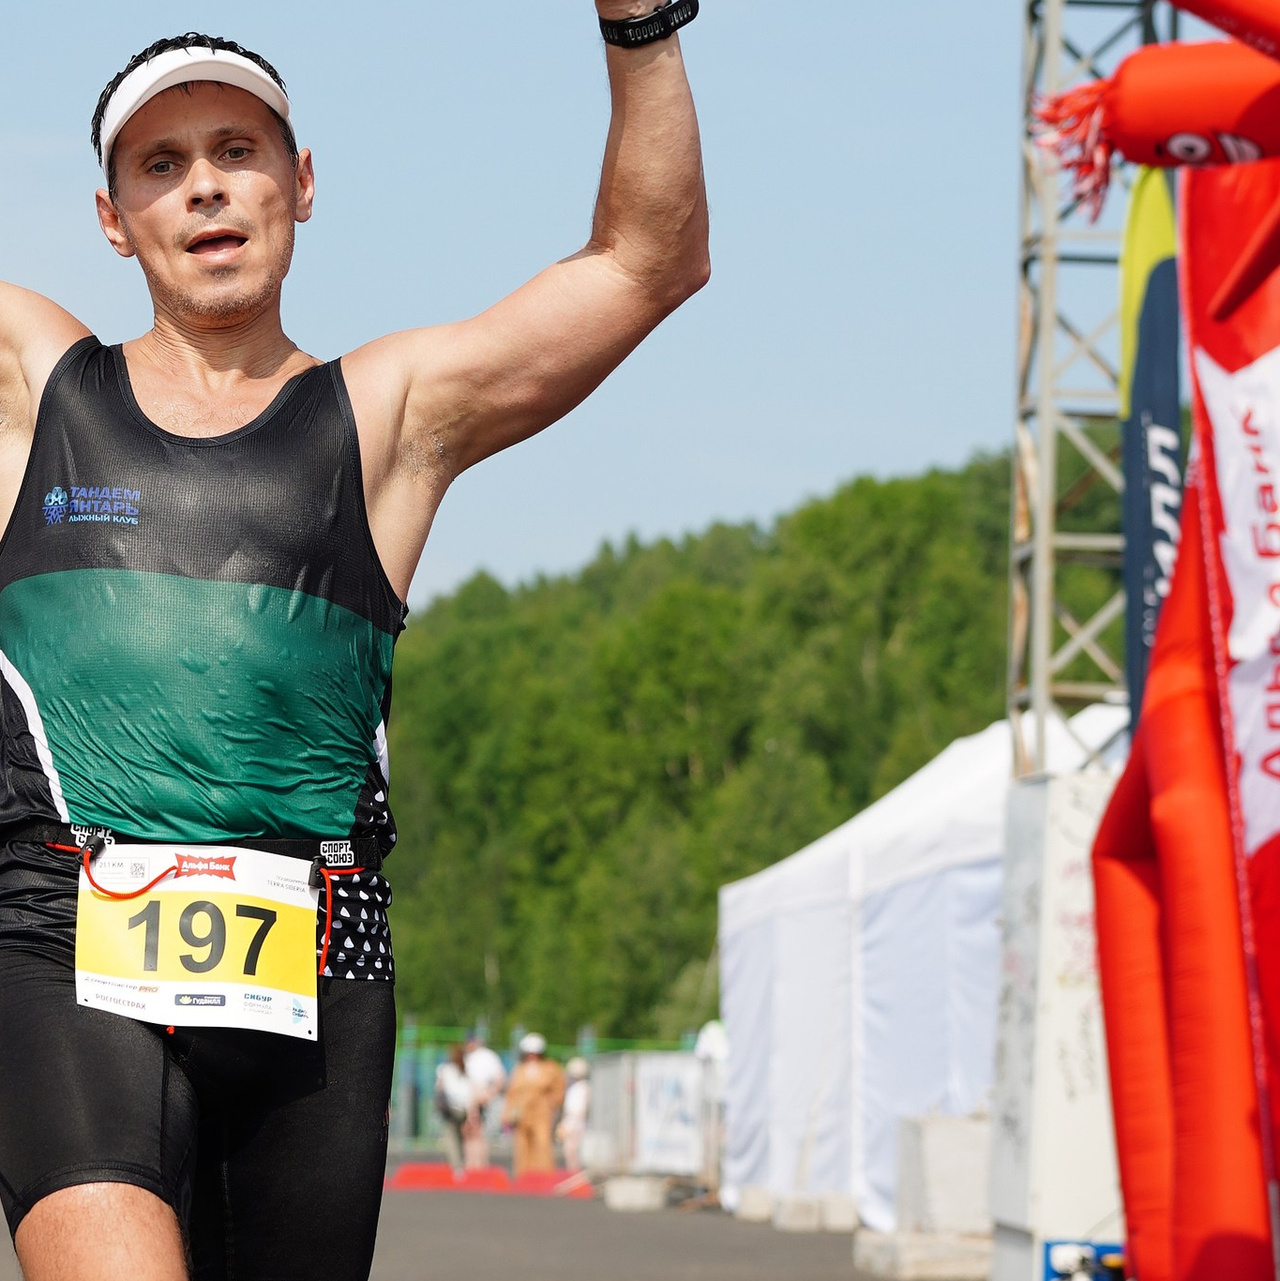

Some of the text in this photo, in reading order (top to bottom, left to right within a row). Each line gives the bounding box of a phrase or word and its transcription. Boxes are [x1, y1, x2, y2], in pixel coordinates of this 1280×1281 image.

[70, 486, 140, 501] ТАНДЕМ
[69, 499, 139, 516] ЯНТАРЬ
[69, 513, 139, 525] ЛЫЖНЫЙ КЛУБ
[322, 842, 349, 853] СПОРТ
[327, 853, 353, 864] СОЮЗ
[181, 860, 230, 872] Альфа Банк
[128, 900, 277, 976] 197
[95, 993, 146, 1010] РОСГОССТРАХ
[244, 993, 273, 1002] СИБУР
